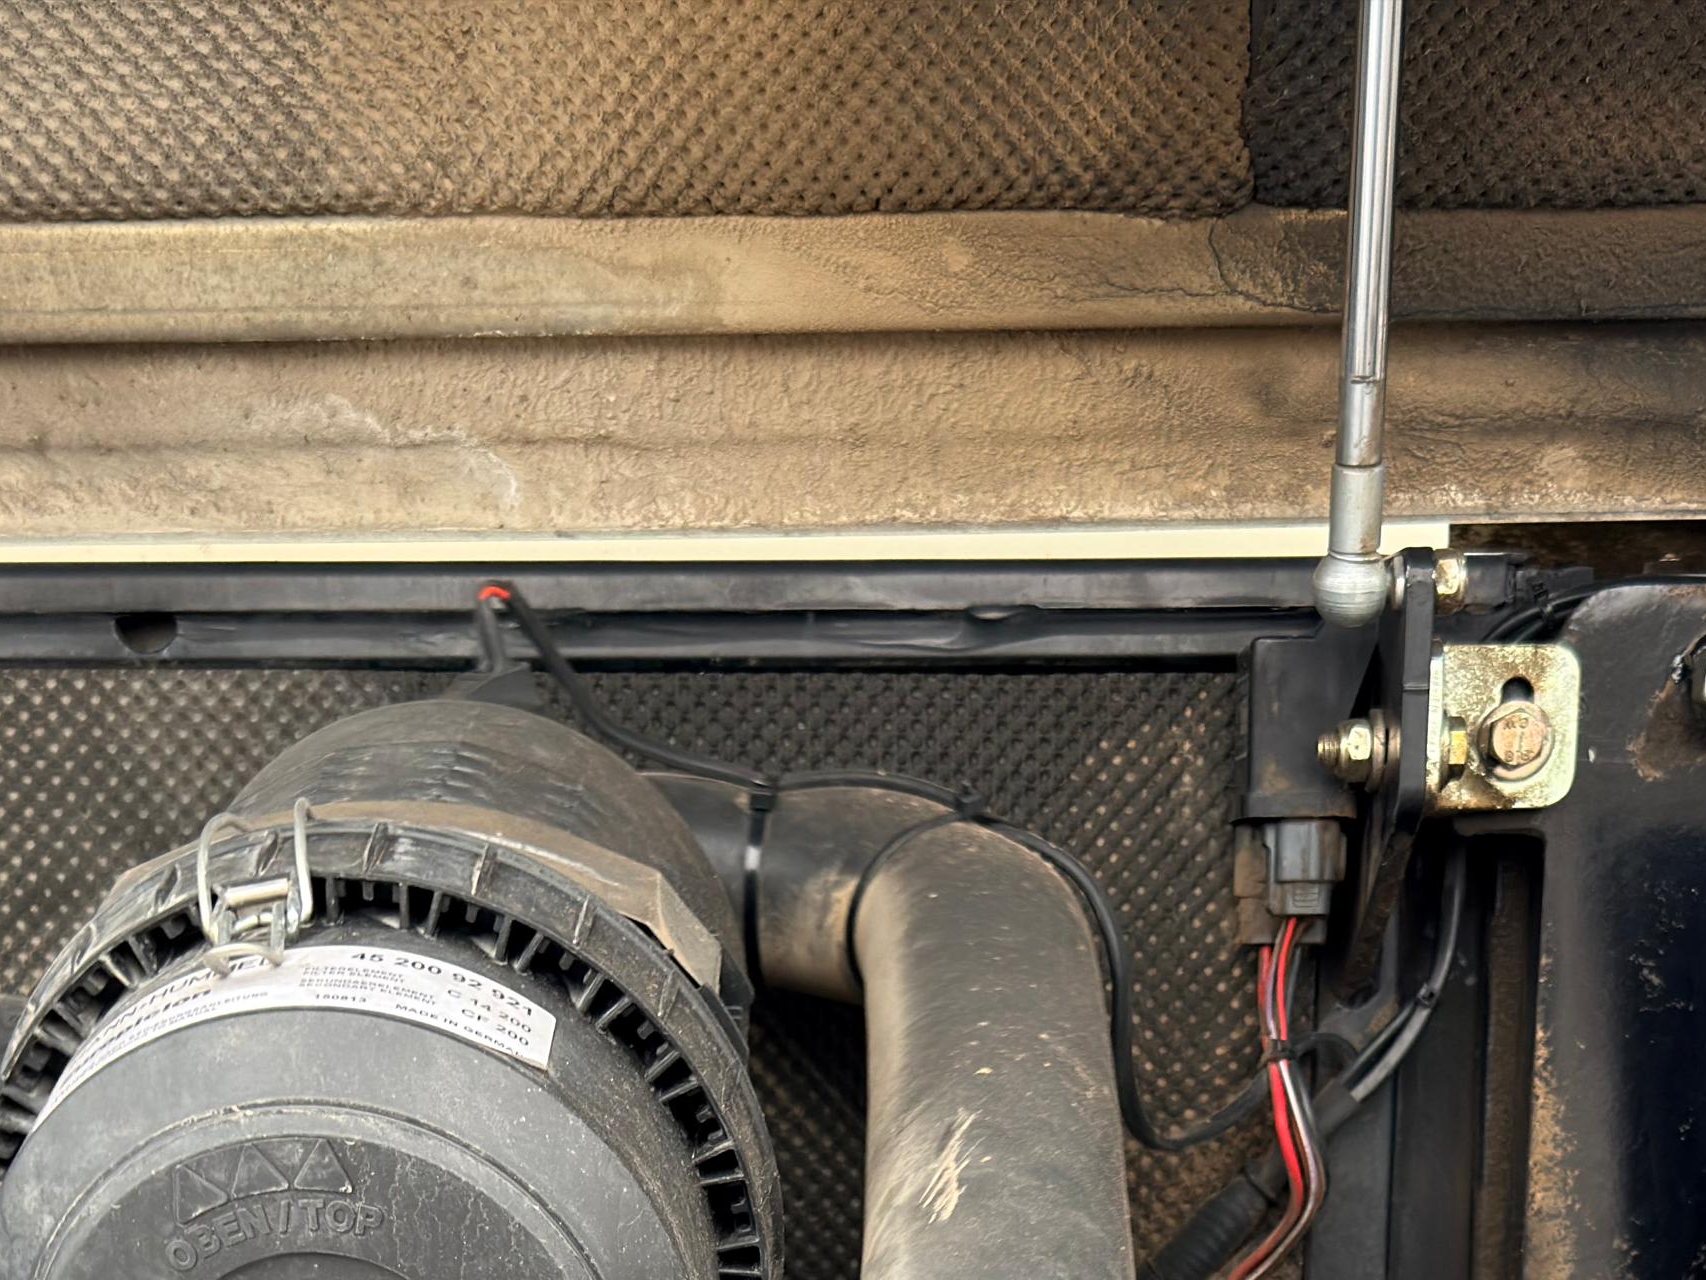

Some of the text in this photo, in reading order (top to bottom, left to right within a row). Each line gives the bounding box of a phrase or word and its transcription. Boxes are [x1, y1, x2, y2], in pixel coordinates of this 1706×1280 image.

[351, 952, 533, 1017] 45 200 92 921
[394, 1003, 440, 1020] MADE
[443, 1017, 459, 1027] IN
[461, 1007, 490, 1023] CF
[496, 1024, 530, 1048] 200
[471, 997, 492, 1013] 14
[499, 1011, 532, 1035] 200
